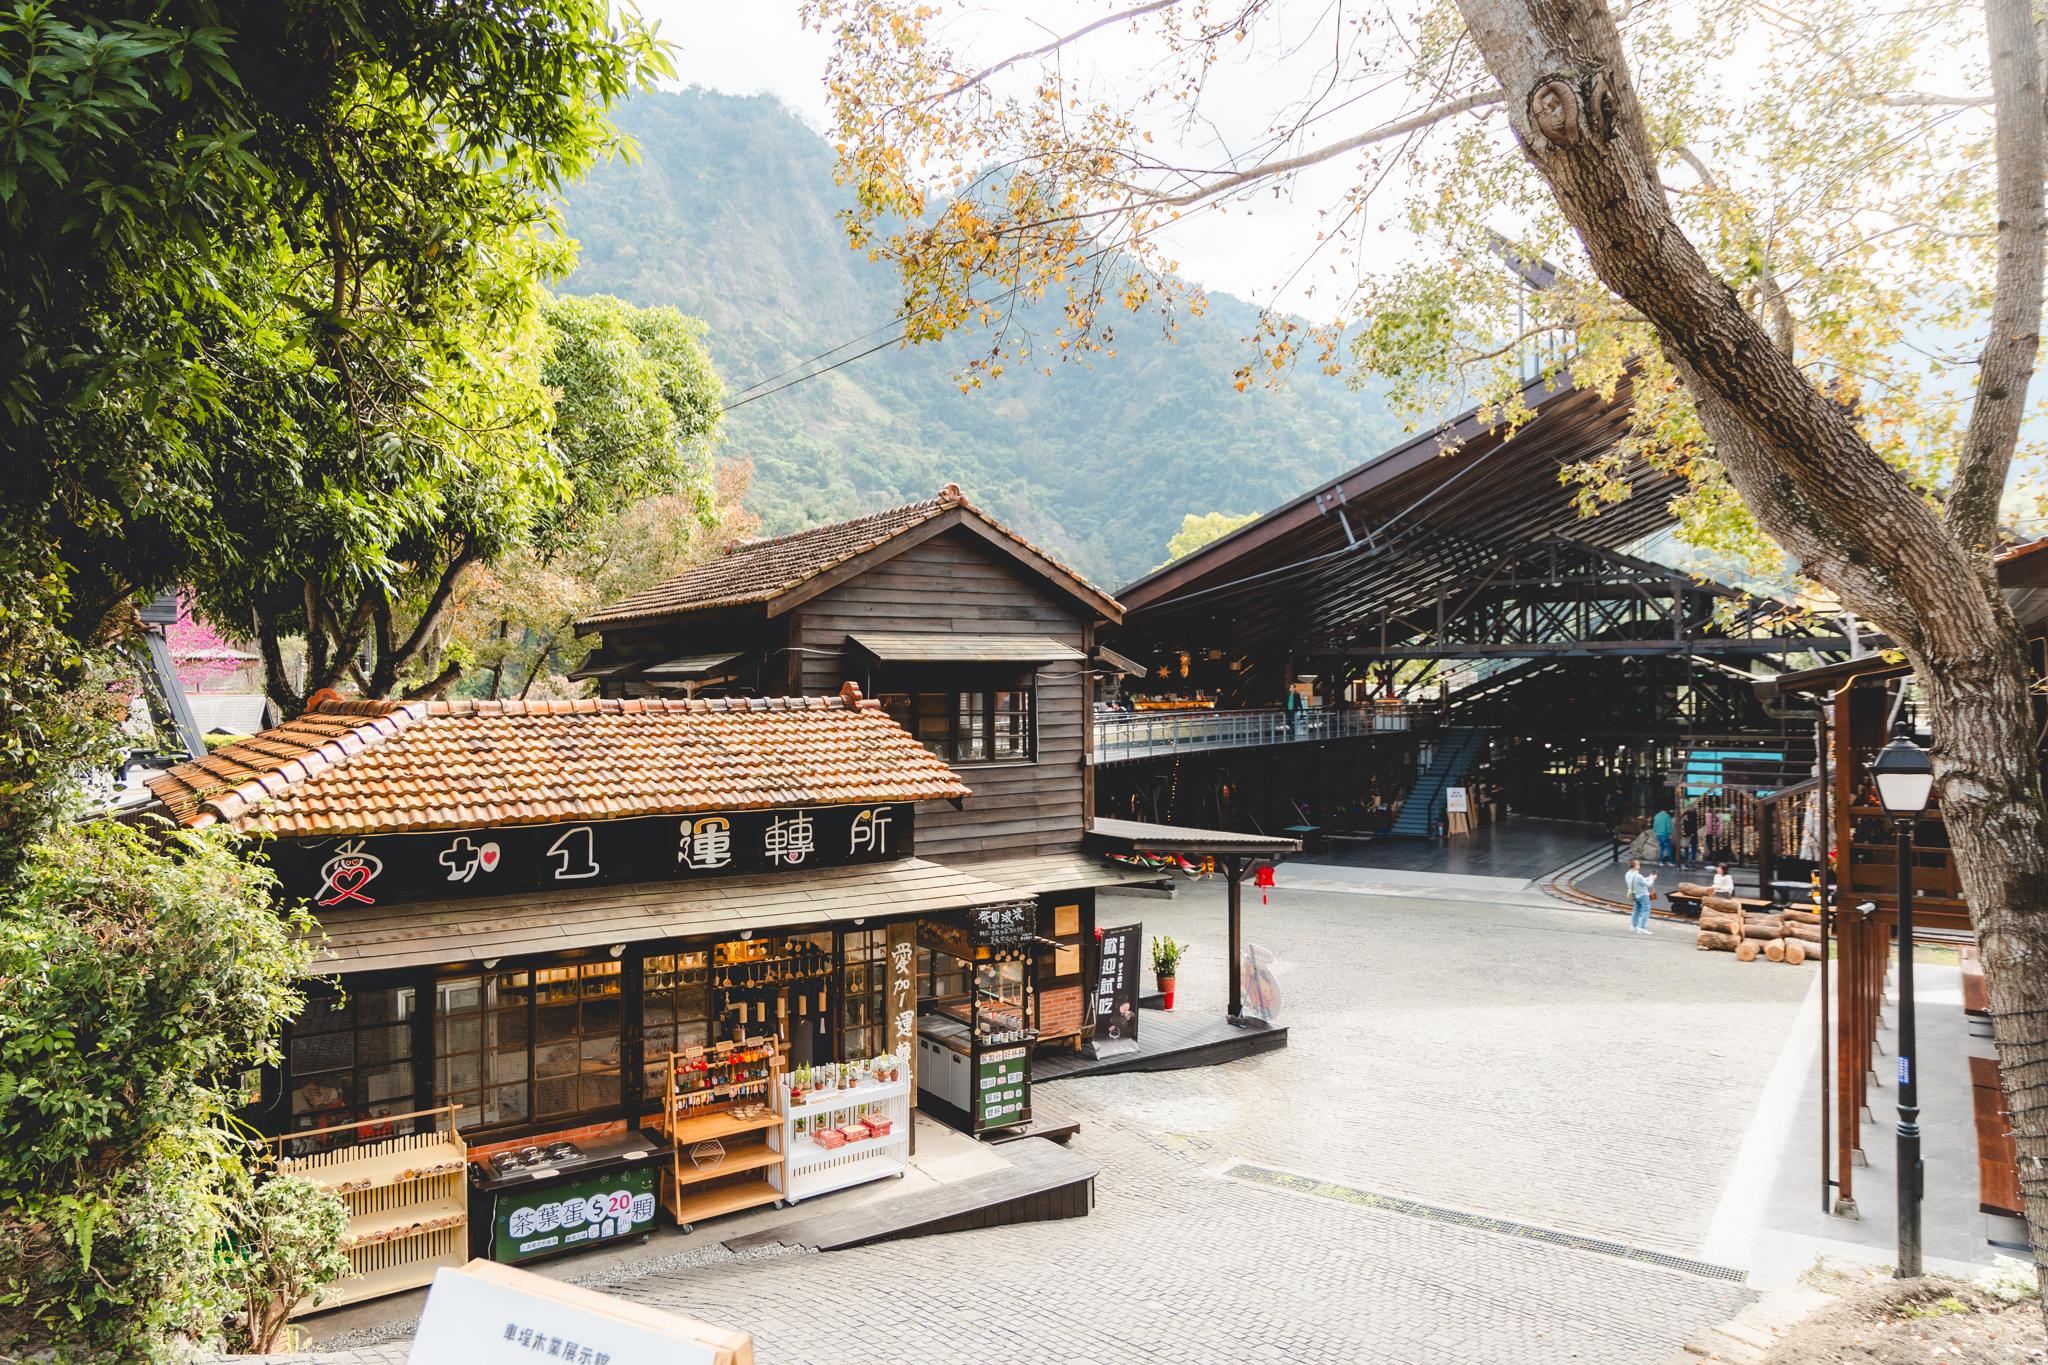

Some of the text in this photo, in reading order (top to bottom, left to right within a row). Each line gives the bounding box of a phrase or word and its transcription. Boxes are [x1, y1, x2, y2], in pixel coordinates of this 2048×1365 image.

[892, 942, 914, 1080] 愛加1運轉
[1098, 937, 1118, 1015] 歡迎試吃
